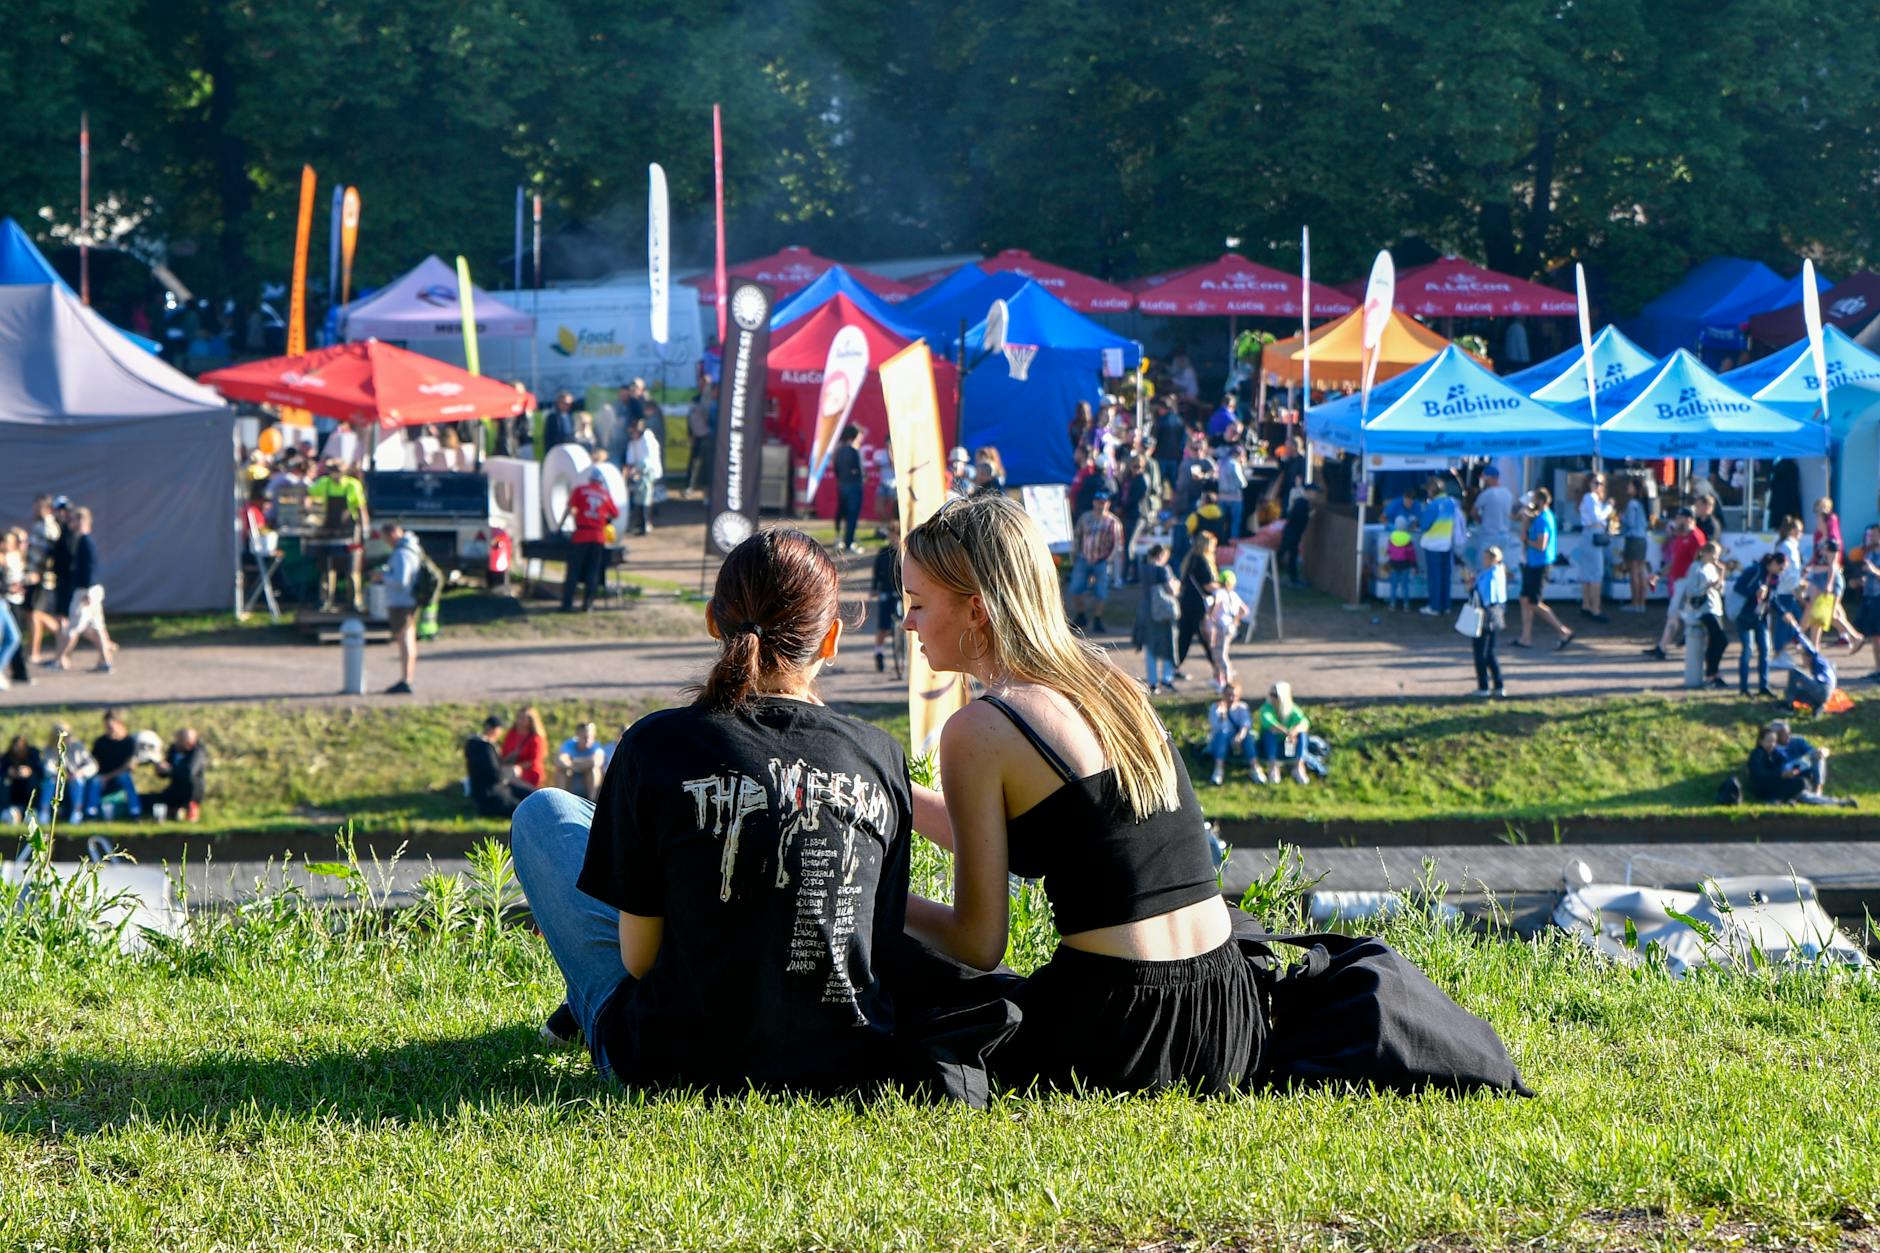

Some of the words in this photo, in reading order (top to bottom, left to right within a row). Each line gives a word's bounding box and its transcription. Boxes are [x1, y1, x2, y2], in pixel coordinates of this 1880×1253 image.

[1422, 396, 1521, 418] Balbiino
[1655, 398, 1752, 420] Balbiino
[801, 878, 825, 887] OSLO
[786, 960, 817, 973] MADRID
